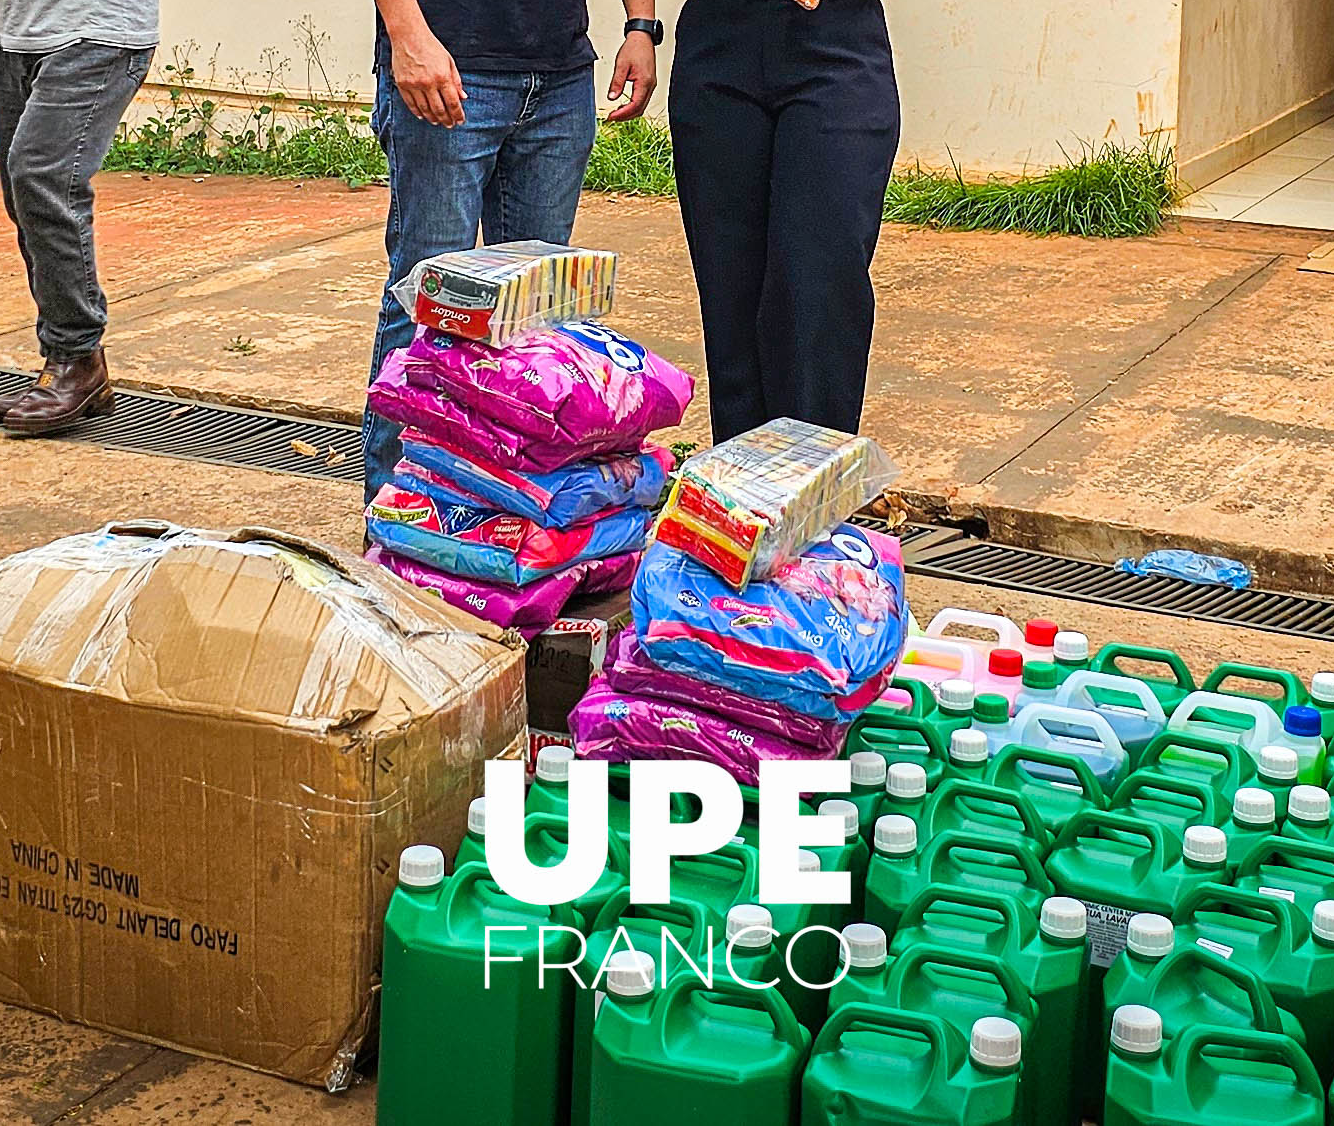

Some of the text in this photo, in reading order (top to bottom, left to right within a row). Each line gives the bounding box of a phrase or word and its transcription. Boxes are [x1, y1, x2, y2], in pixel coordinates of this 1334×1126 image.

[430, 306, 471, 324] Condor
[465, 593, 487, 611] 4kg
[797, 629, 824, 647] 4kg
[824, 613, 852, 641] 4kg
[726, 728, 755, 747] 4kg
[10, 838, 140, 899] MADE IN CHINA
[17, 880, 58, 913] TITAN
[62, 893, 108, 925] CG125
[116, 906, 181, 942] DELANT
[191, 923, 239, 956] FARO
